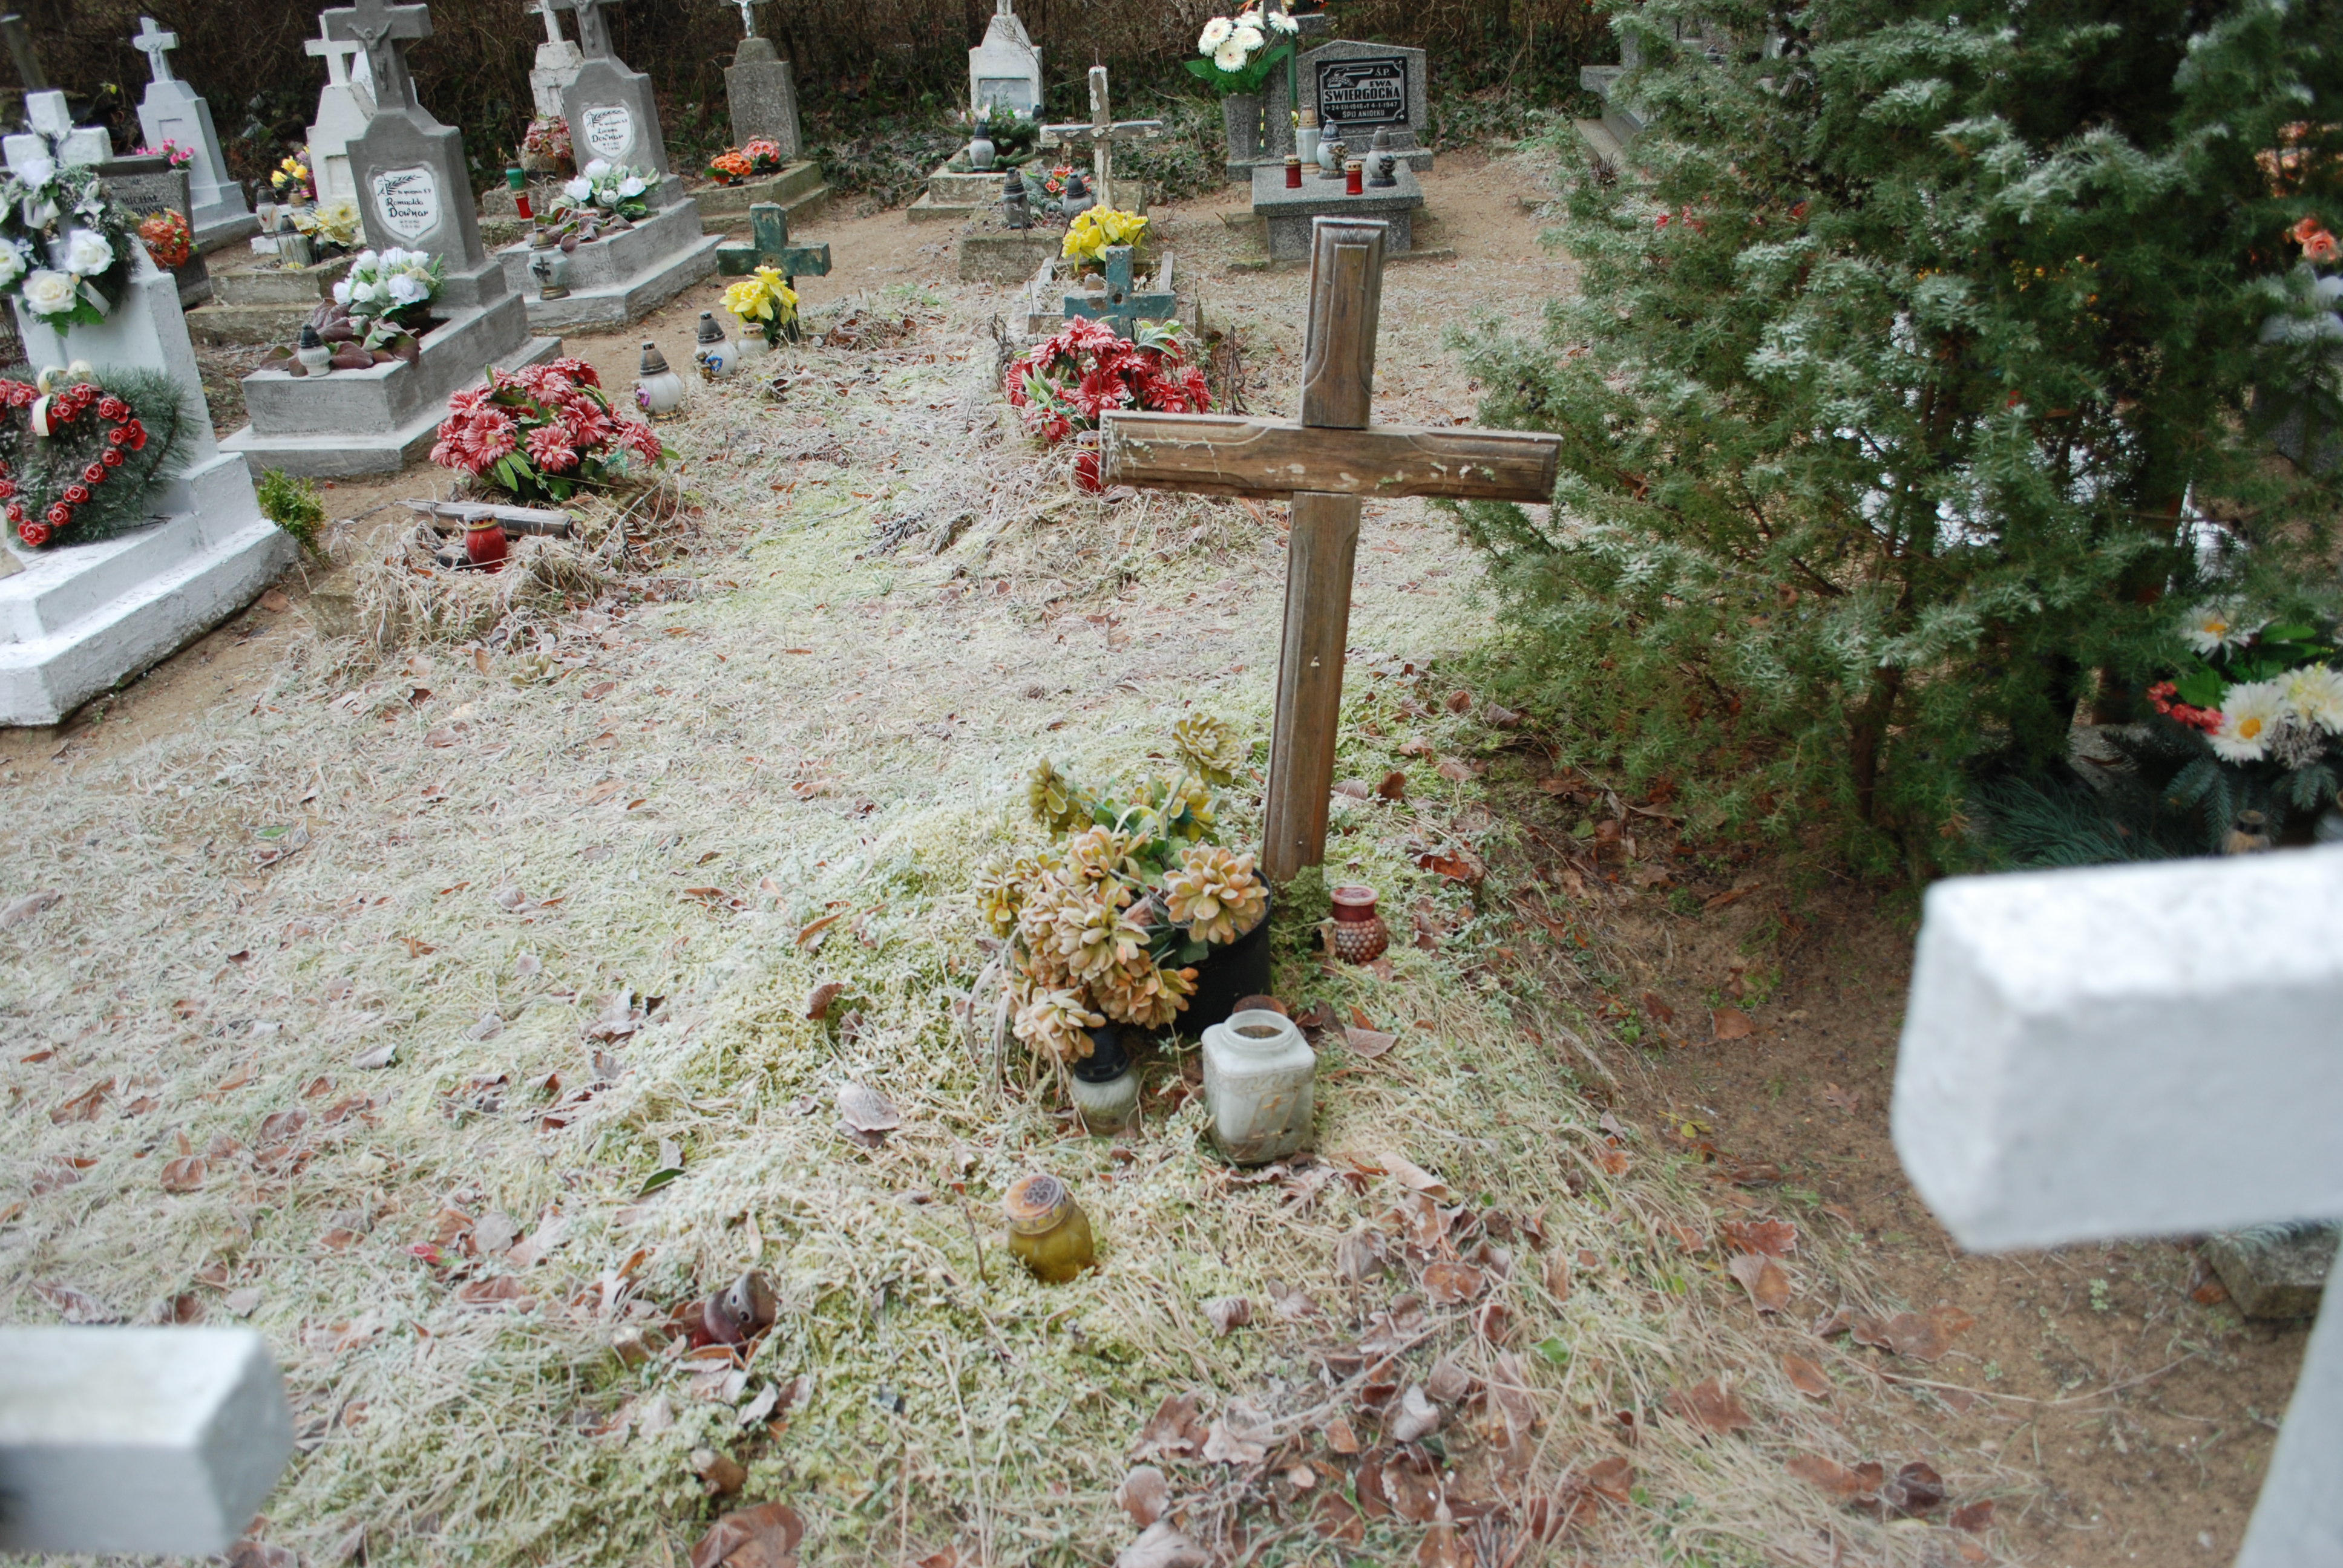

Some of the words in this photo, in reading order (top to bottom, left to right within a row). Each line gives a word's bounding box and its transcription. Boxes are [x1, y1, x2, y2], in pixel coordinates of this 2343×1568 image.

[1358, 109, 1385, 118] ANIOŁKU
[121, 195, 160, 204] MICHAŁ
[385, 197, 424, 208] Romualda
[388, 207, 428, 217] Downar
